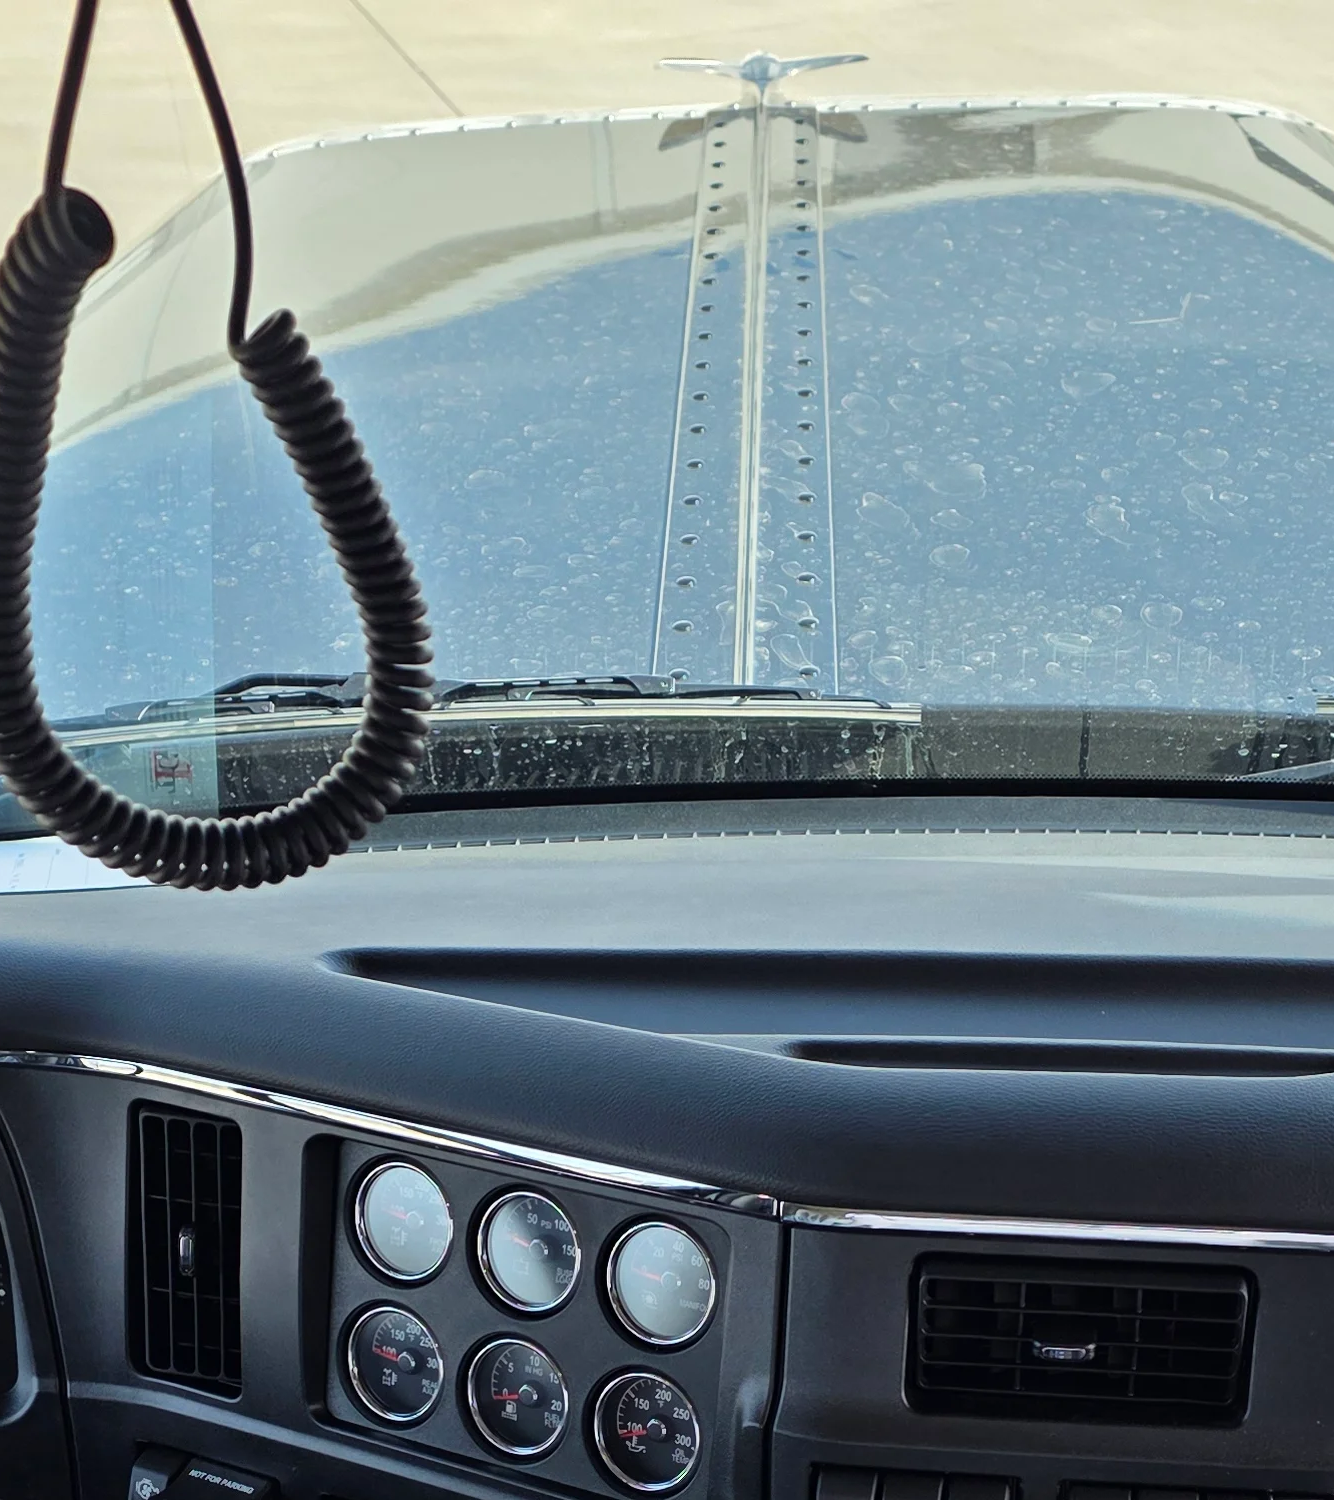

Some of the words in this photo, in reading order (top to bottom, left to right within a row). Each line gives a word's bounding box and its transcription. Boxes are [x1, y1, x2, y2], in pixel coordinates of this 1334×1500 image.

[527, 1212, 538, 1225] 50
[653, 1245, 665, 1258] 20
[673, 1240, 684, 1253] 40
[691, 1254, 703, 1268] 60
[698, 1278, 710, 1291] 80
[391, 1328, 405, 1342] 150
[406, 1322, 421, 1337] 200
[508, 1362, 514, 1373] 5
[530, 1355, 540, 1367] 10
[655, 1388, 672, 1402] 200
[551, 1399, 562, 1412] 20
[634, 1397, 650, 1411] 150
[673, 1407, 690, 1421] 250
[675, 1433, 692, 1447] 300
[188, 1469, 207, 1480] NOT
[205, 1473, 223, 1484] FOR
